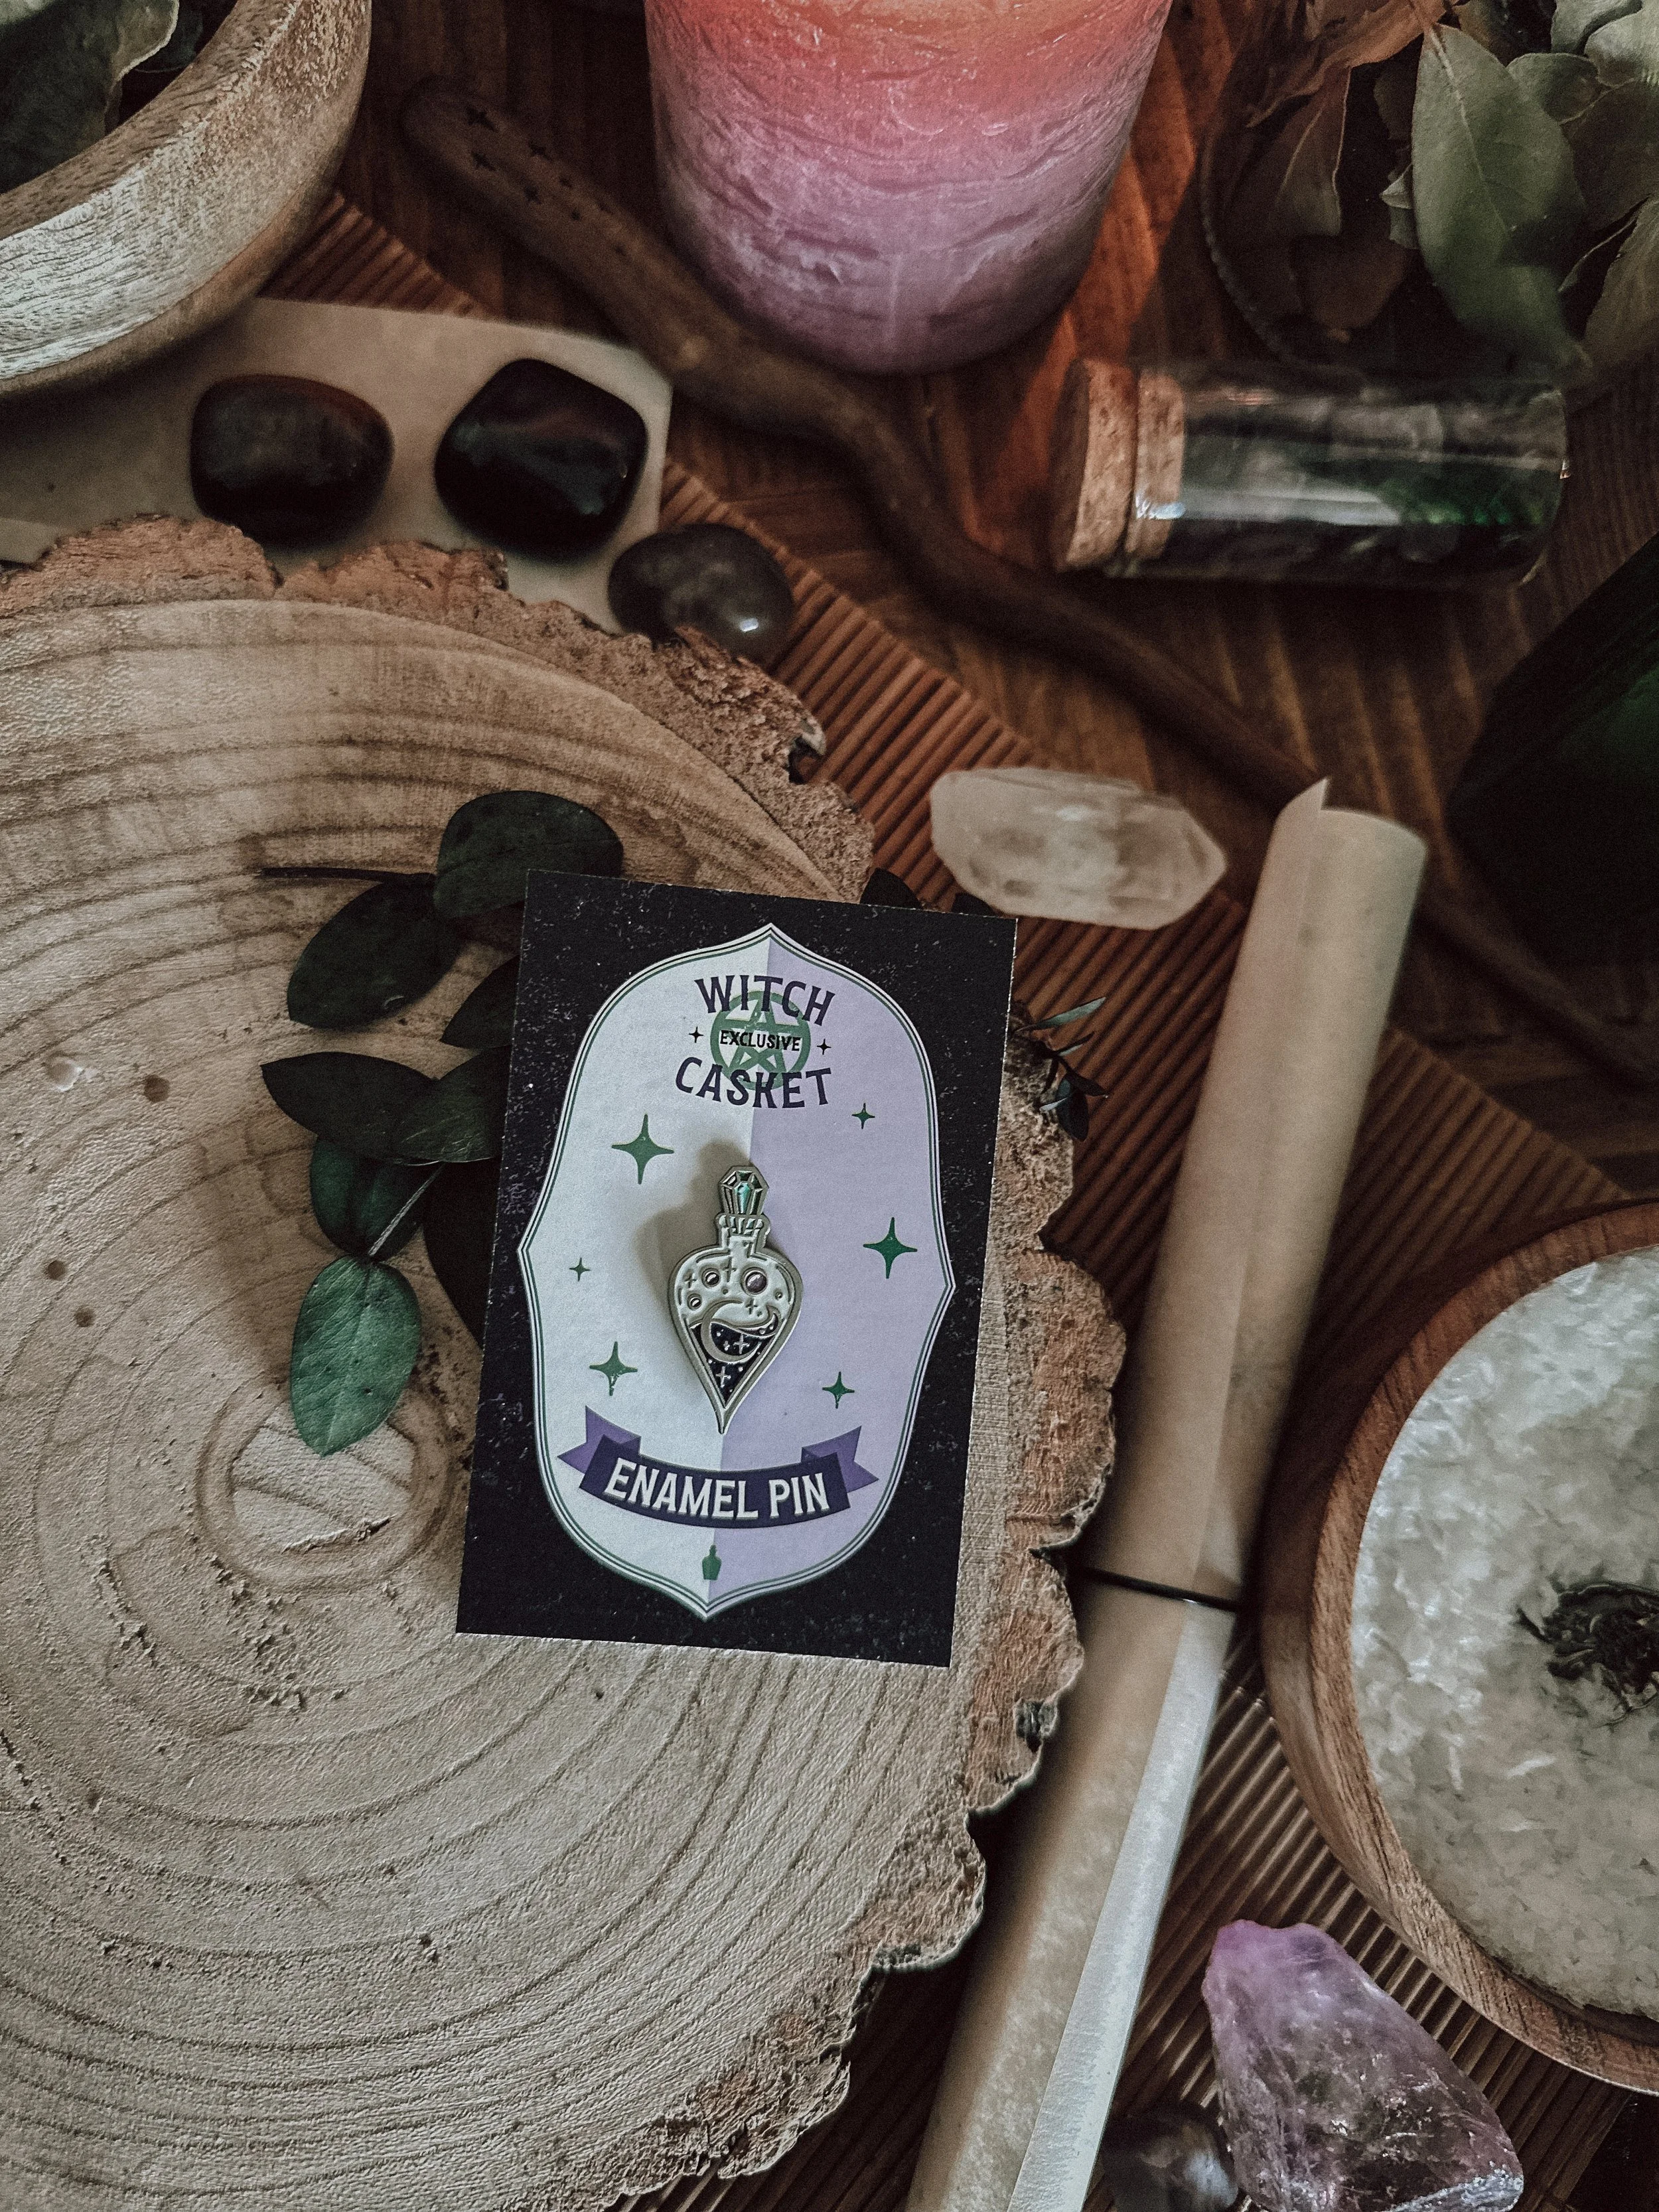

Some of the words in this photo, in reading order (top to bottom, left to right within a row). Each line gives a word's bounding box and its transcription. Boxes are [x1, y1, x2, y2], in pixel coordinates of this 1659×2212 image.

[694, 975, 835, 1026] WITCH
[719, 1029, 801, 1051] EXCLUSIVE
[675, 1057, 831, 1108] CASKET
[603, 1457, 758, 1519] ENAMEL
[768, 1473, 830, 1518] PIN
